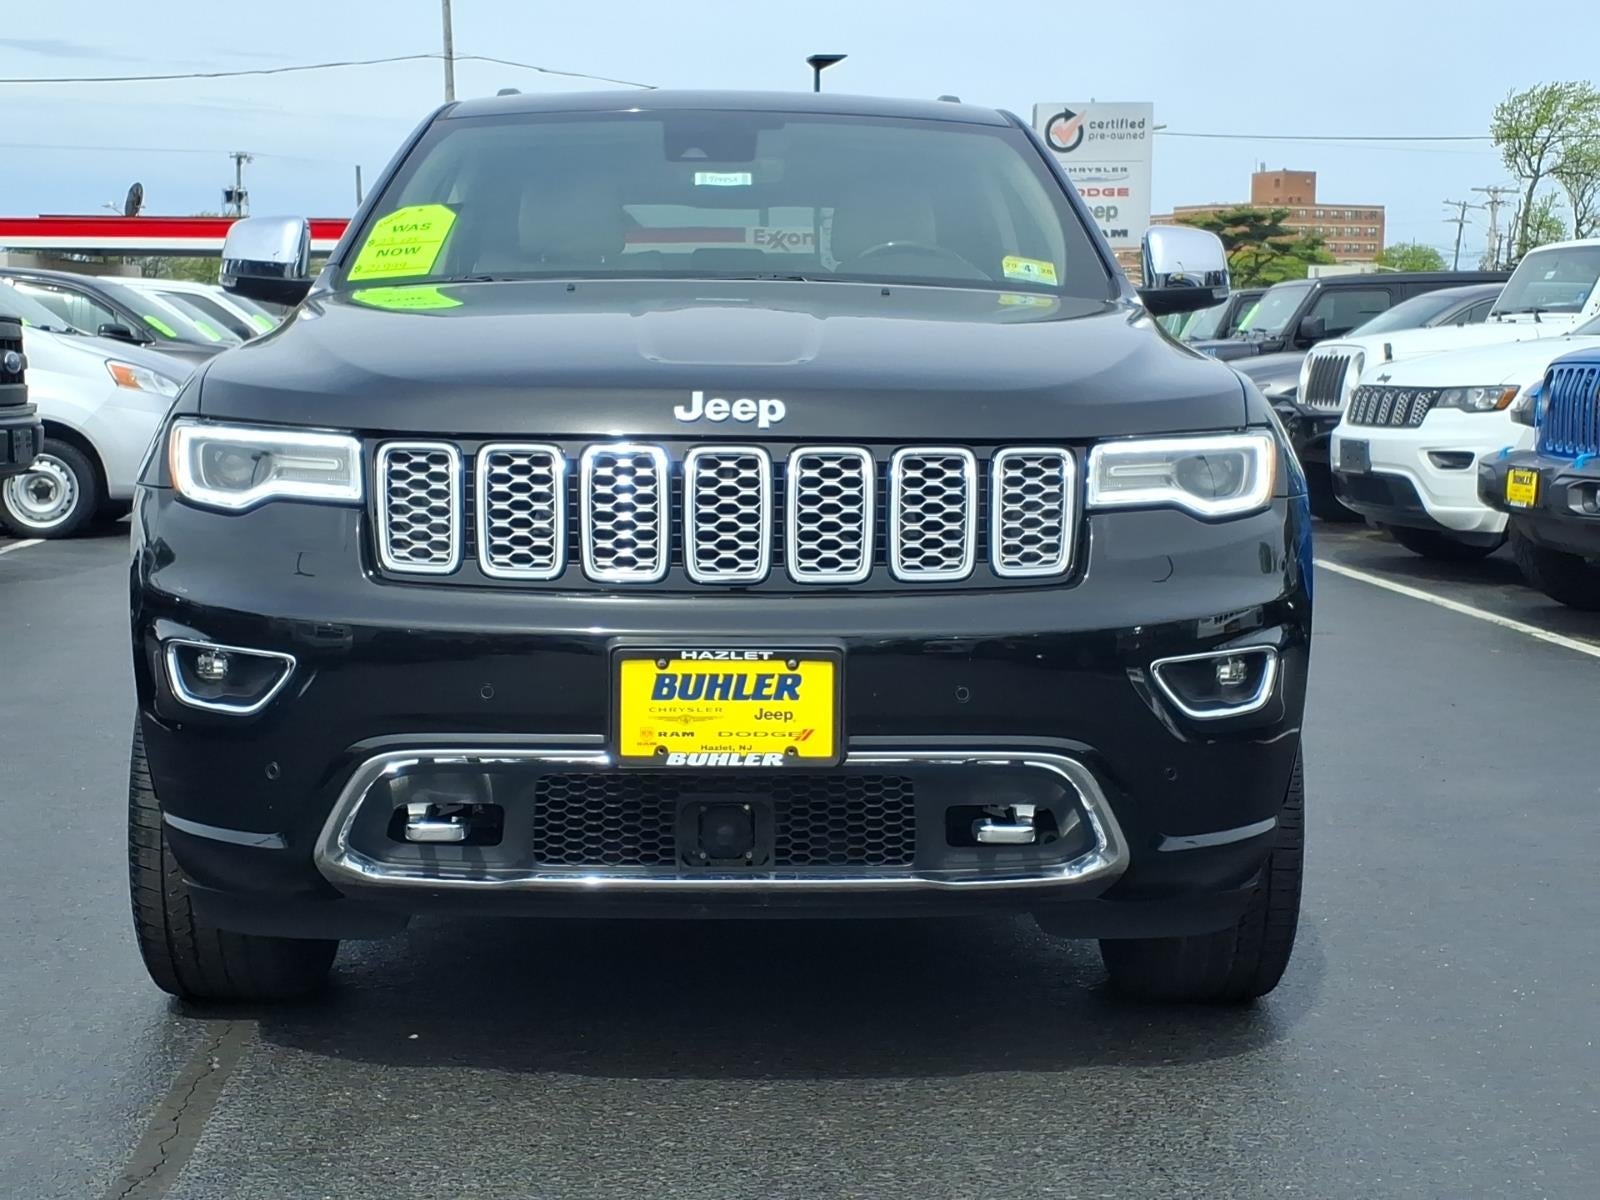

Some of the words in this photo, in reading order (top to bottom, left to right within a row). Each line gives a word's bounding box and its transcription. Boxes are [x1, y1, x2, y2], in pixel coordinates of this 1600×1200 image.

[1089, 118, 1145, 129] certified
[1088, 131, 1145, 141] pre-owned
[1078, 187, 1130, 197] DGE
[1089, 205, 1119, 222] ep
[392, 222, 432, 232] WAS
[754, 229, 815, 250] Exxon
[376, 246, 422, 257] NOW
[673, 390, 786, 429] Jeep
[681, 651, 773, 660] HAZLET
[651, 673, 802, 701] BUHLER
[754, 708, 793, 723] Jeep
[700, 743, 736, 752] Hazlet,
[666, 752, 784, 766] BUHLER
